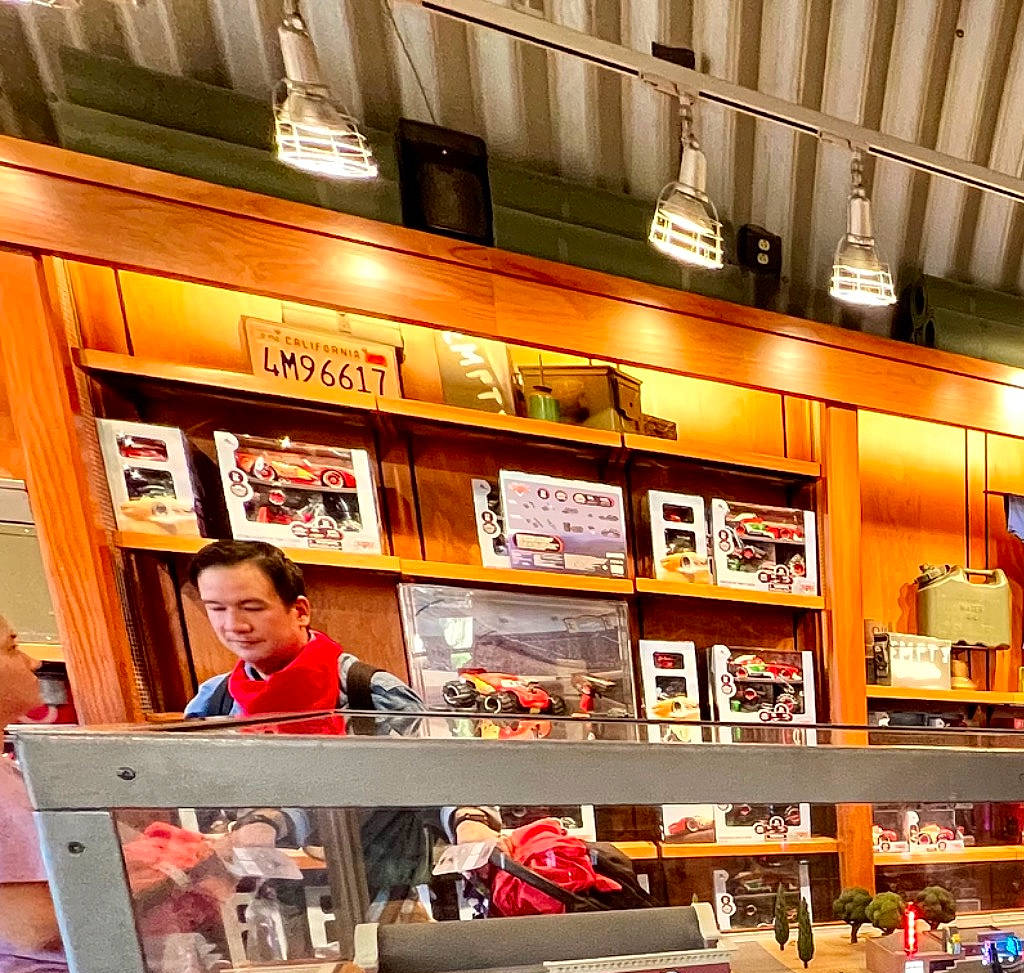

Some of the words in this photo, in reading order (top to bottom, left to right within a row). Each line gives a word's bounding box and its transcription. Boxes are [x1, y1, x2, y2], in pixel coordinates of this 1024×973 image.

[285, 336, 361, 360] CALIFORNIA
[263, 346, 386, 396] 4M96617
[442, 330, 507, 416] MPT
[890, 640, 951, 664] EMPTY
